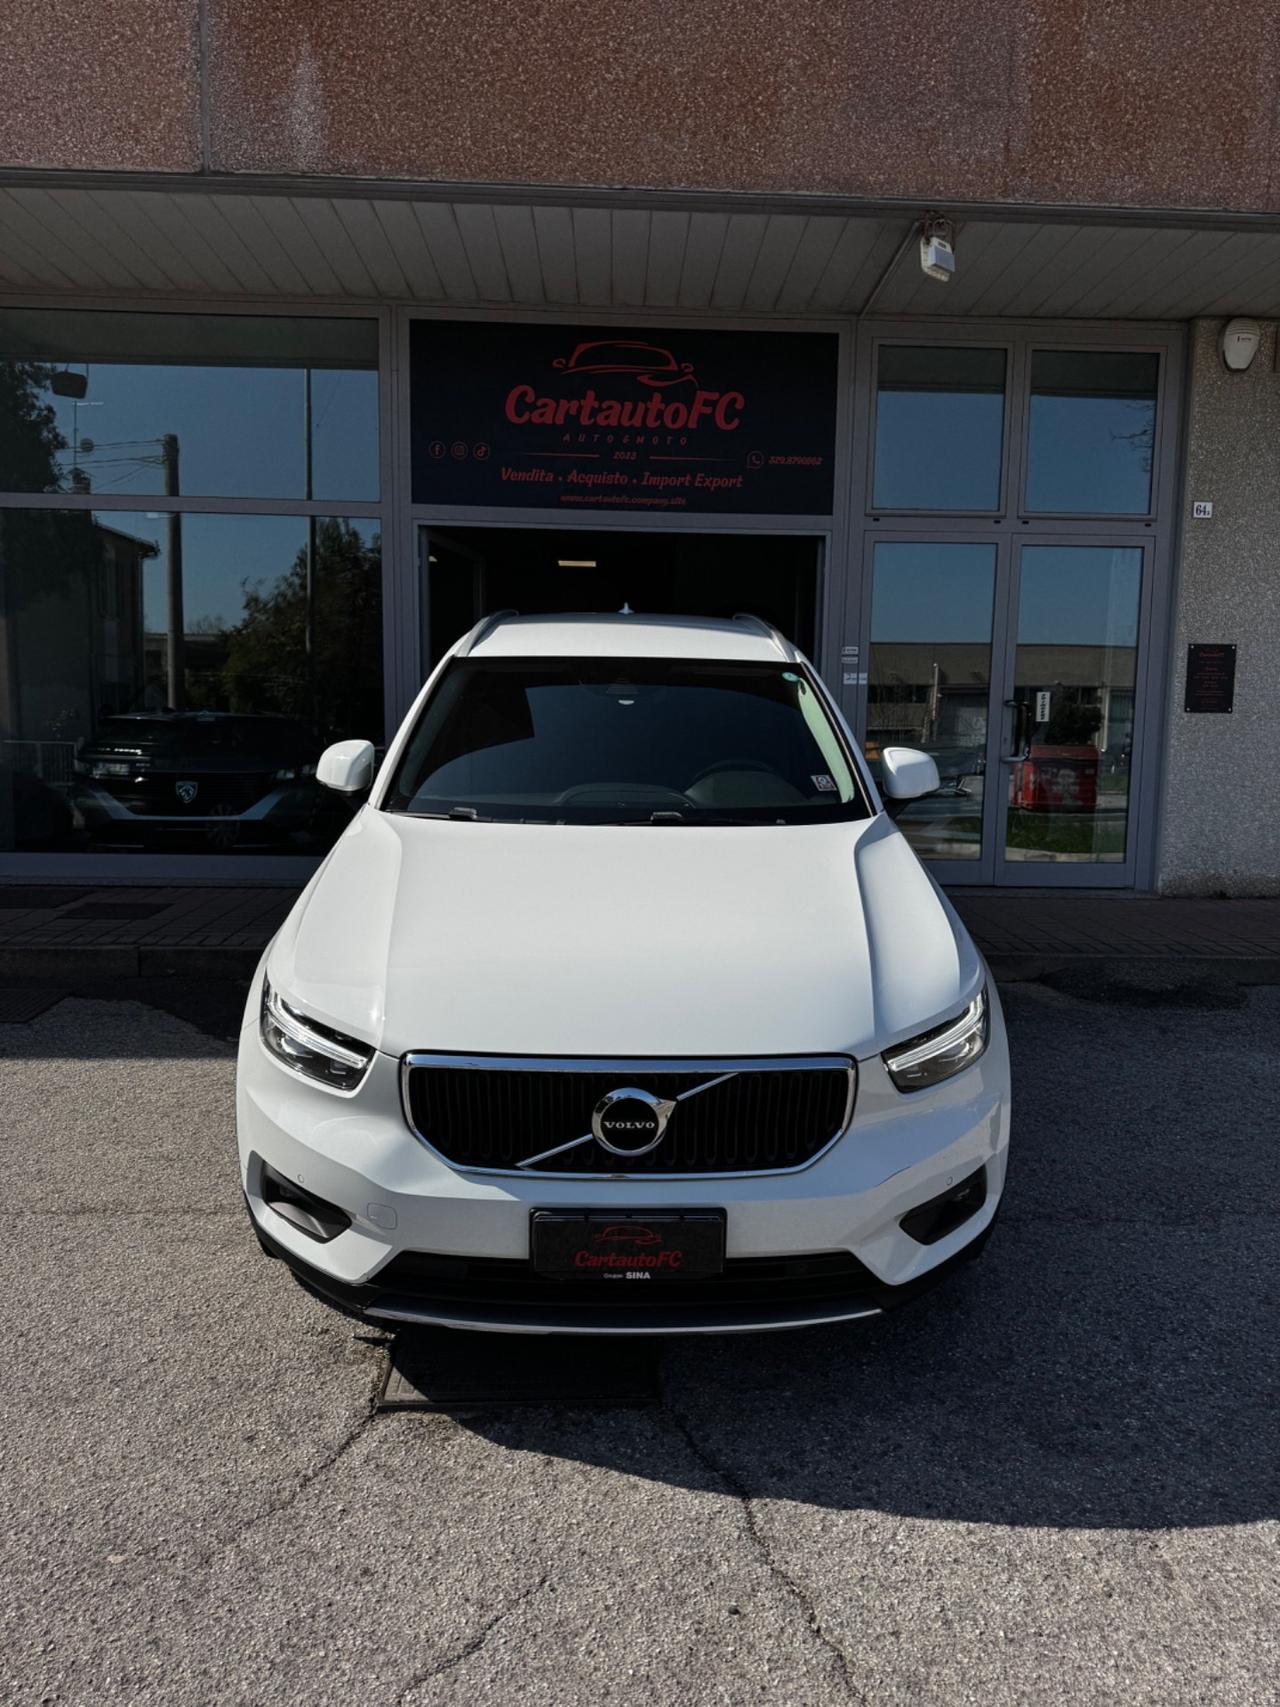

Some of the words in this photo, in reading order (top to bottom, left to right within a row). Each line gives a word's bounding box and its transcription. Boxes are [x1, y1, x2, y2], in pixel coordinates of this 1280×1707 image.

[505, 384, 745, 431] CartautoFC
[500, 467, 554, 483] Vendita
[567, 469, 629, 488] Acquisto
[640, 471, 691, 490] Import
[694, 473, 744, 492] Export
[603, 1121, 656, 1129] VOLVO
[574, 1250, 683, 1269] CartautoFC
[625, 1271, 651, 1280] SINA
